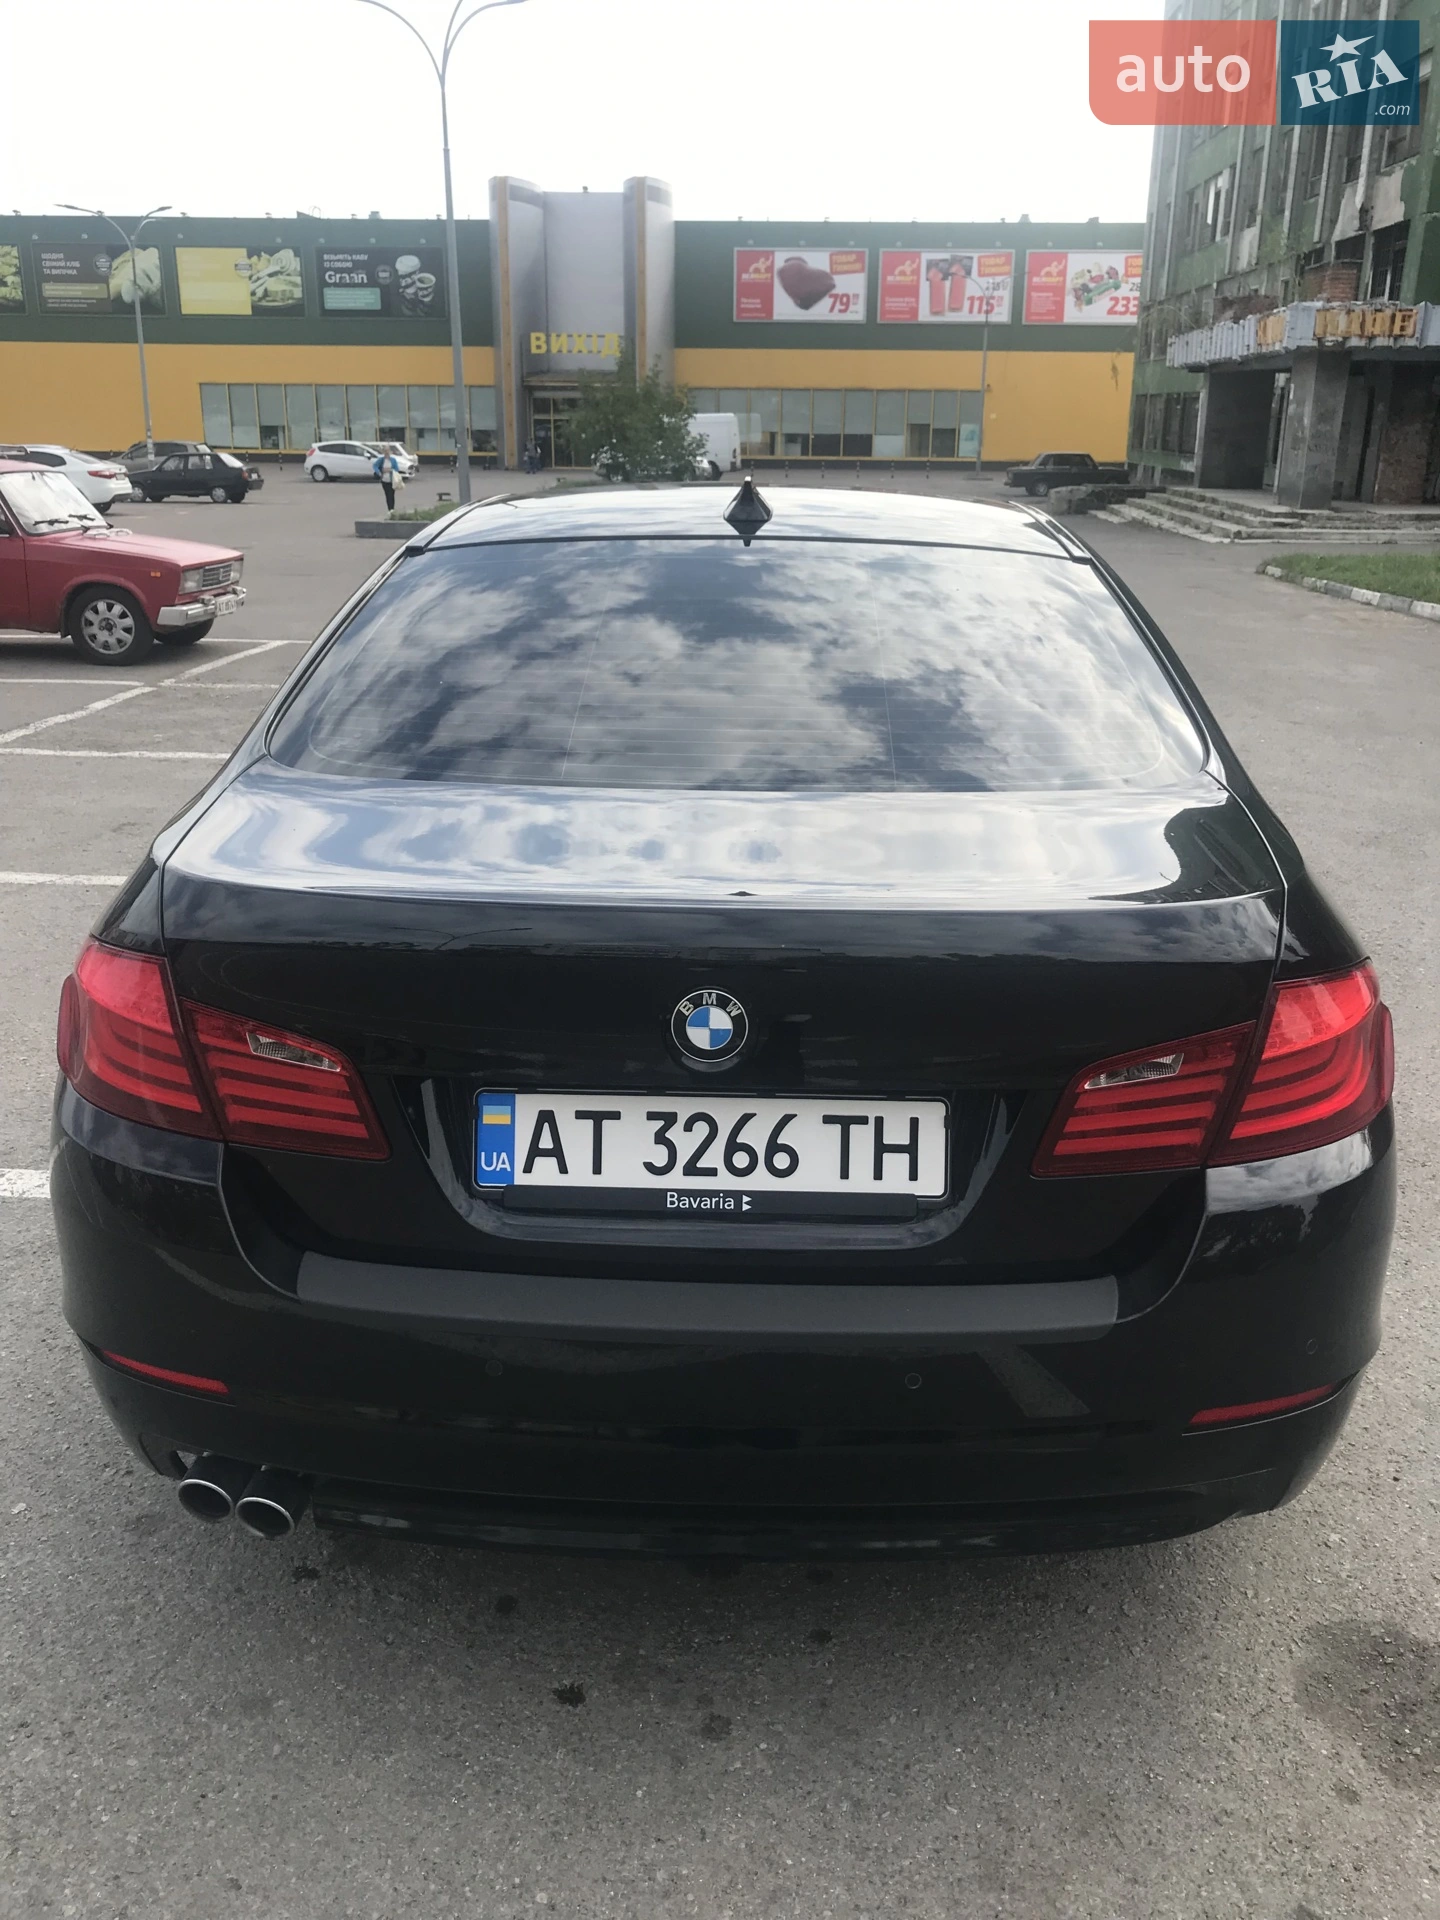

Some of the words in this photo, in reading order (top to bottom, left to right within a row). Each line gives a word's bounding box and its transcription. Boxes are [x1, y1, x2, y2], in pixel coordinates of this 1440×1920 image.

[827, 293, 851, 313] 79
[530, 332, 621, 359] ВИХІД
[679, 992, 742, 1017] BMW
[522, 1109, 621, 1175] AT
[642, 1111, 800, 1178] 3266
[822, 1114, 919, 1181] TH
[481, 1151, 511, 1172] UA
[665, 1191, 735, 1210] Bavaria
